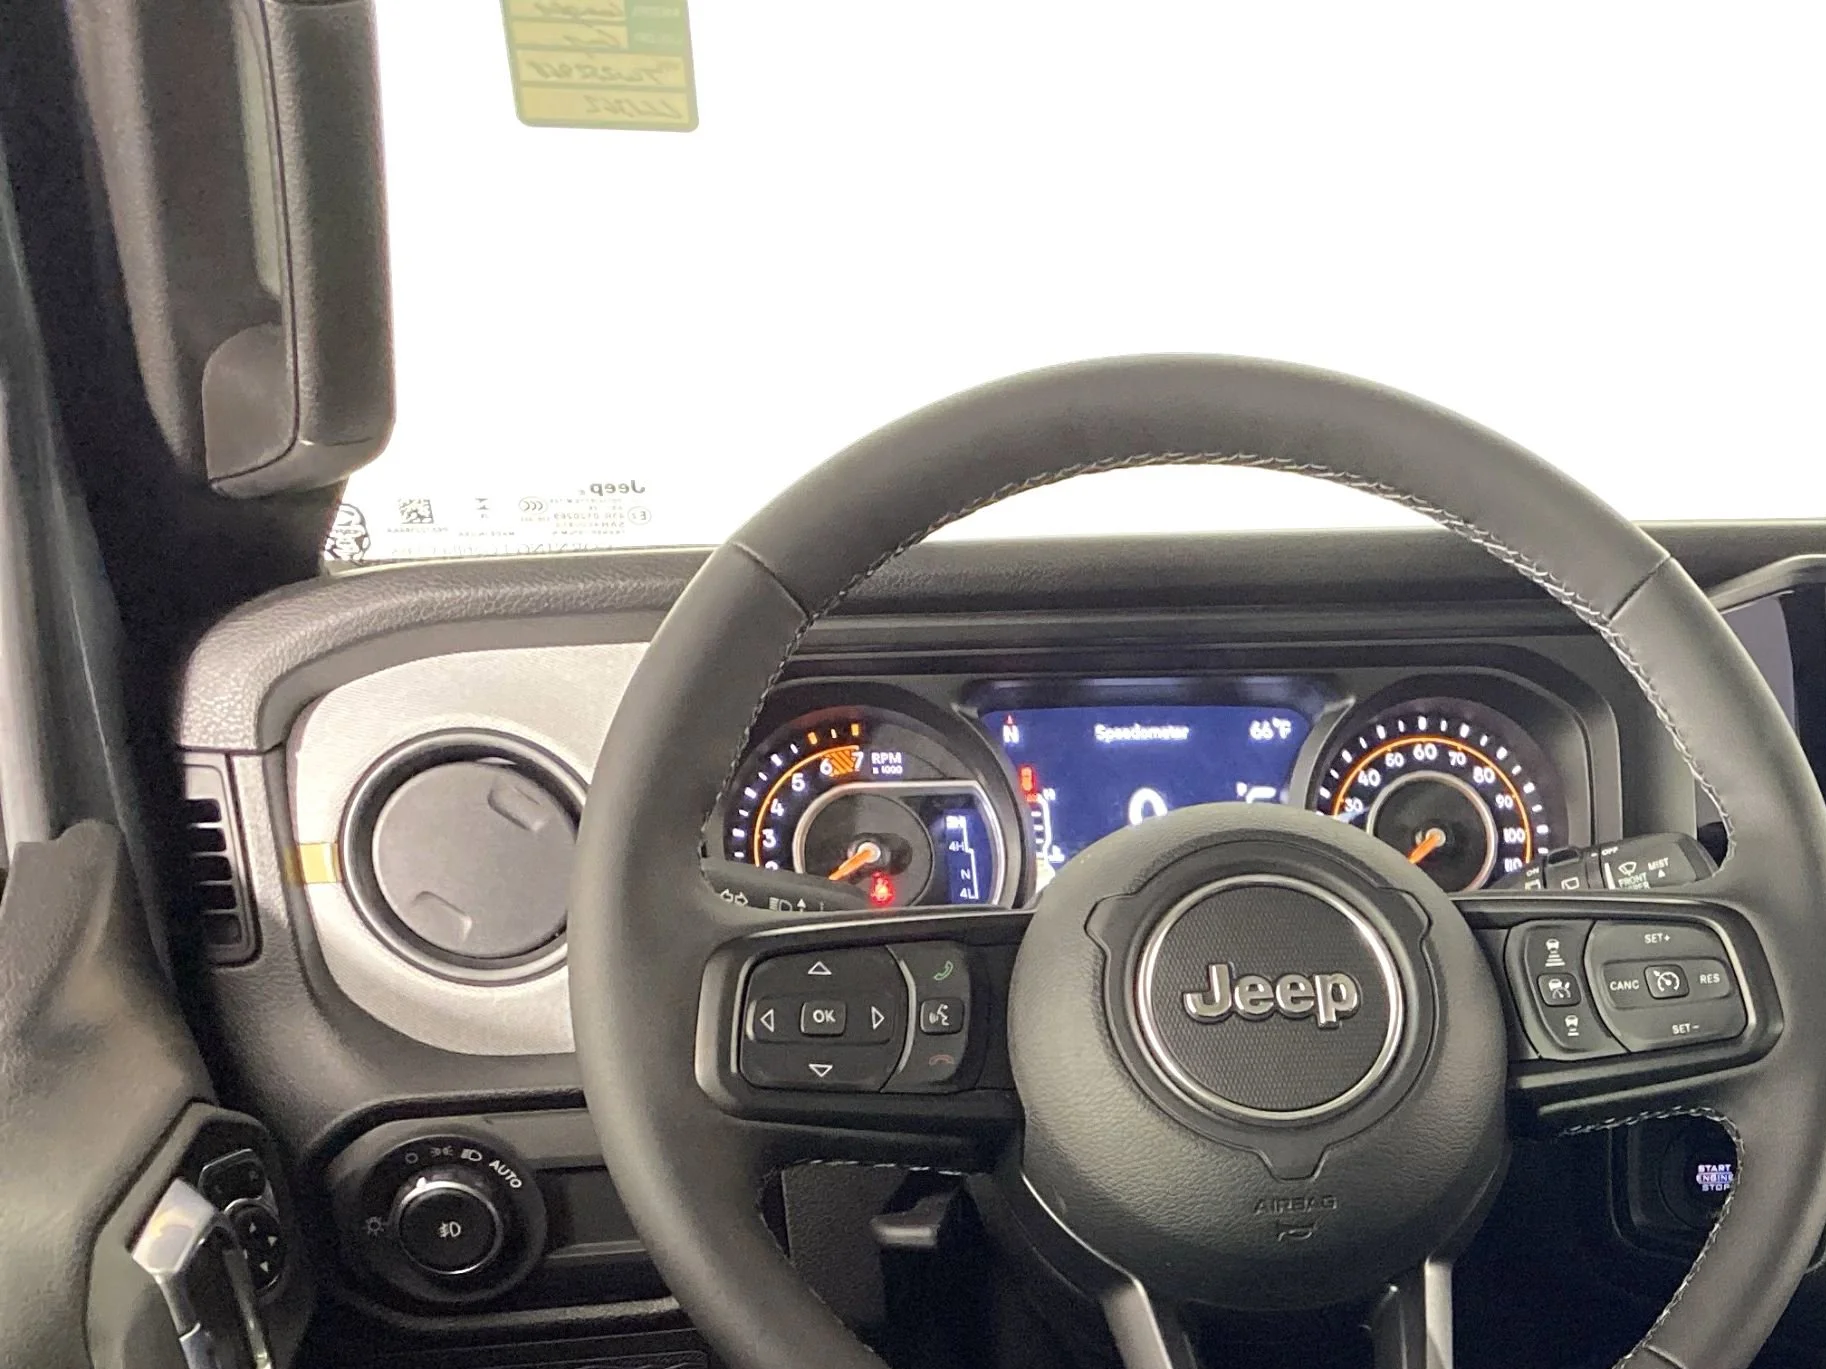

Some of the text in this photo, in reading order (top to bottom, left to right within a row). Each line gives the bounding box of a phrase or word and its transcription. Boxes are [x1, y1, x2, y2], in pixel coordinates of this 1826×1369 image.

[1002, 725, 1020, 744] N
[1093, 722, 1190, 744] Speedometer
[871, 751, 903, 765] RPM
[1385, 752, 1405, 768] 50
[1412, 743, 1438, 761] 60
[1449, 751, 1467, 766] 70
[819, 758, 833, 775] 6
[851, 751, 865, 771] 7
[880, 765, 903, 774] 1000
[1473, 766, 1496, 784] 80
[791, 773, 806, 791] 5
[1357, 769, 1381, 787] 40
[770, 798, 785, 816] 4
[1343, 797, 1364, 813] 30
[1495, 793, 1514, 809] 90
[762, 828, 777, 848] 3
[1502, 827, 1526, 844] 100
[948, 841, 968, 851] 4H
[1601, 846, 1619, 857] OFF
[1526, 867, 1540, 877] ON
[1647, 857, 1669, 871] MIST
[960, 869, 971, 880] N
[1618, 871, 1647, 888] FRONT
[1609, 979, 1640, 992] CANC
[1699, 973, 1721, 985] RES
[1182, 962, 1362, 1030] Jeep
[812, 1009, 836, 1023] OK
[488, 1159, 523, 1189] AUTO
[1697, 1163, 1731, 1172] START
[1701, 1184, 1731, 1192] STOP
